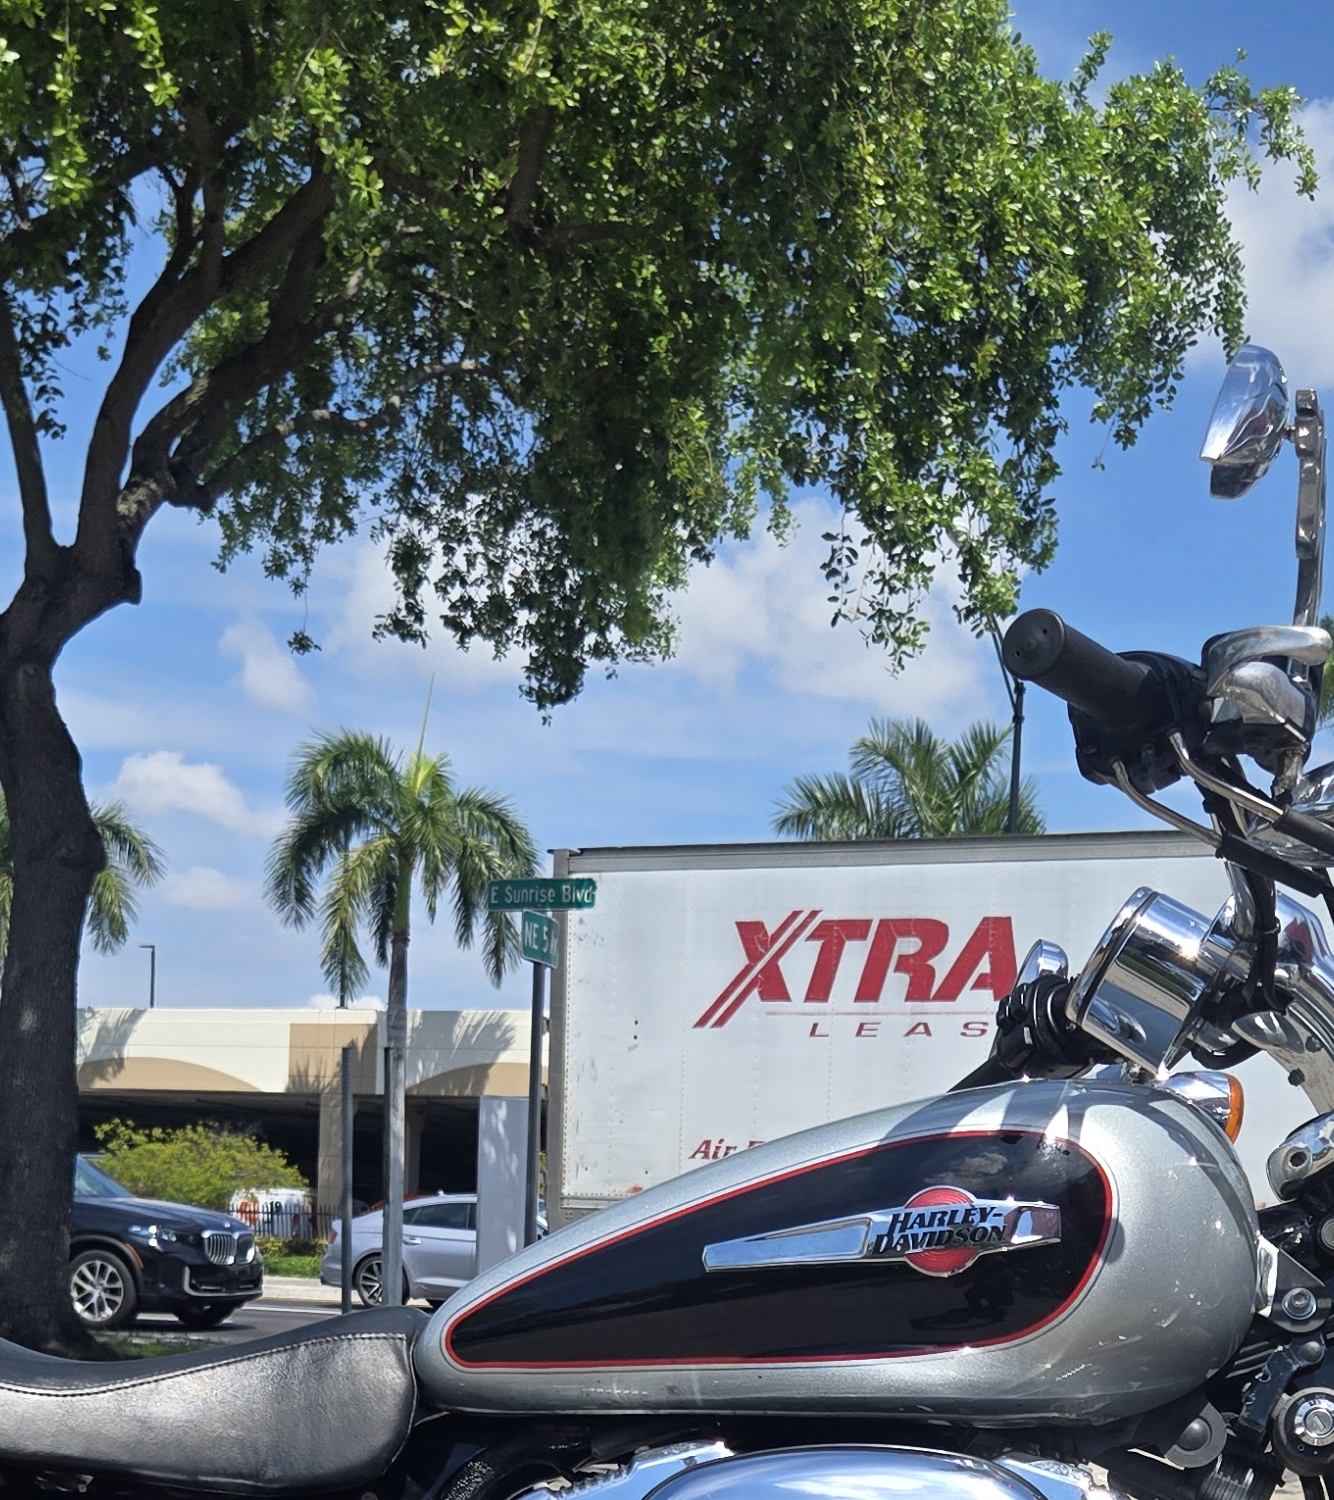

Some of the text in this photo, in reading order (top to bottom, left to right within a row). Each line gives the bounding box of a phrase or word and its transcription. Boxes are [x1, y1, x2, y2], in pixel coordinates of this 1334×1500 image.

[490, 884, 594, 904] E Sunrise Blvd
[524, 920, 540, 950] NE
[542, 926, 549, 954] 5
[692, 909, 1018, 1029] XTRA
[687, 1138, 738, 1161] Air
[887, 1206, 1004, 1234] HARLEY-
[873, 1225, 1007, 1254] DAVIDSON
